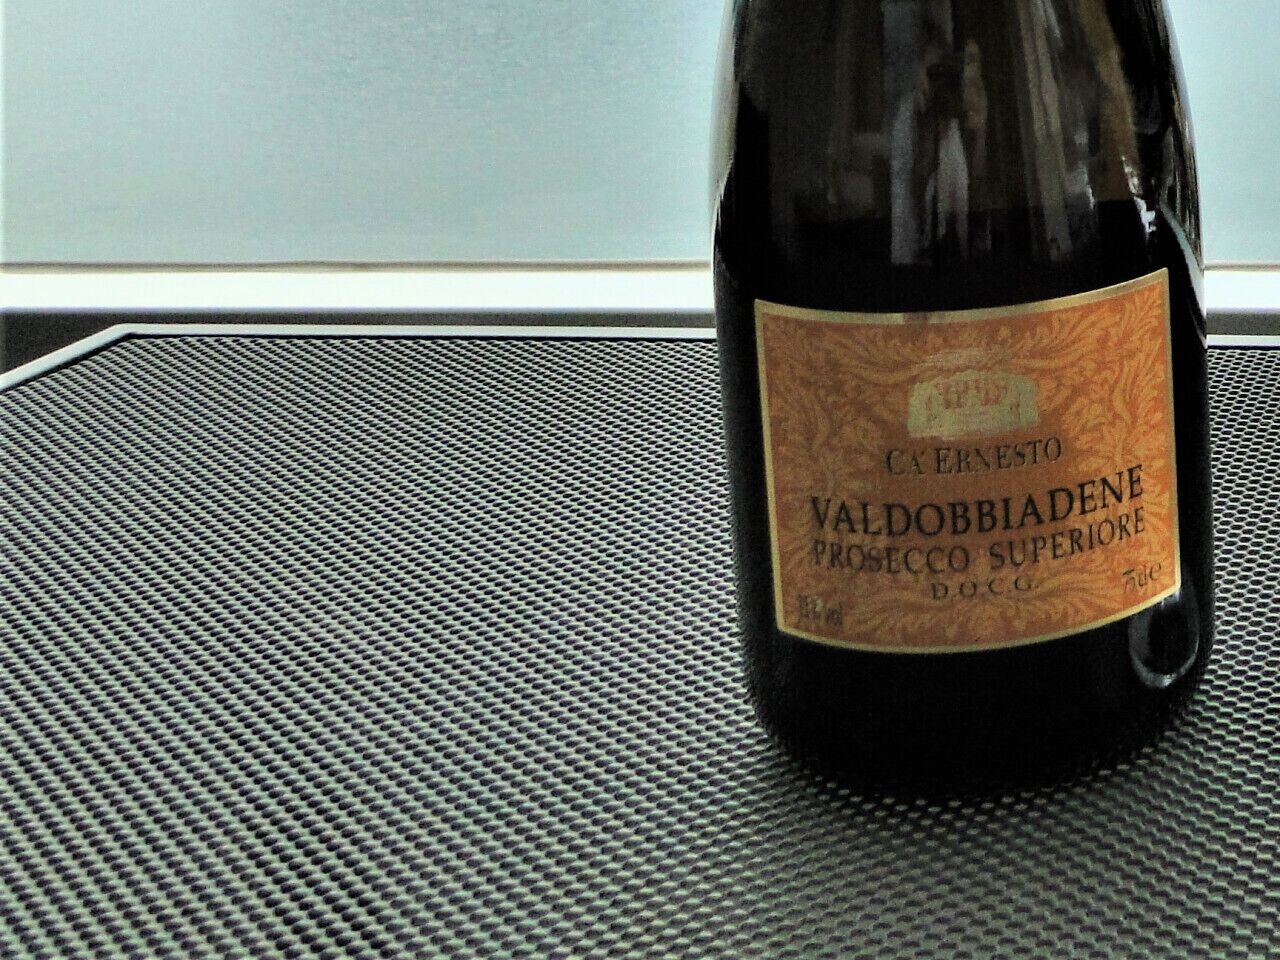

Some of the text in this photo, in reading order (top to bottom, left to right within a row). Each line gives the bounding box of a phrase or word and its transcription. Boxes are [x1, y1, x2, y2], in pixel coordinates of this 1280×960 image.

[935, 436, 1063, 475] ERNESTO
[810, 464, 1144, 538] VALDOBBIADENE
[813, 505, 1146, 576] PROSECCO SUPERIORE
